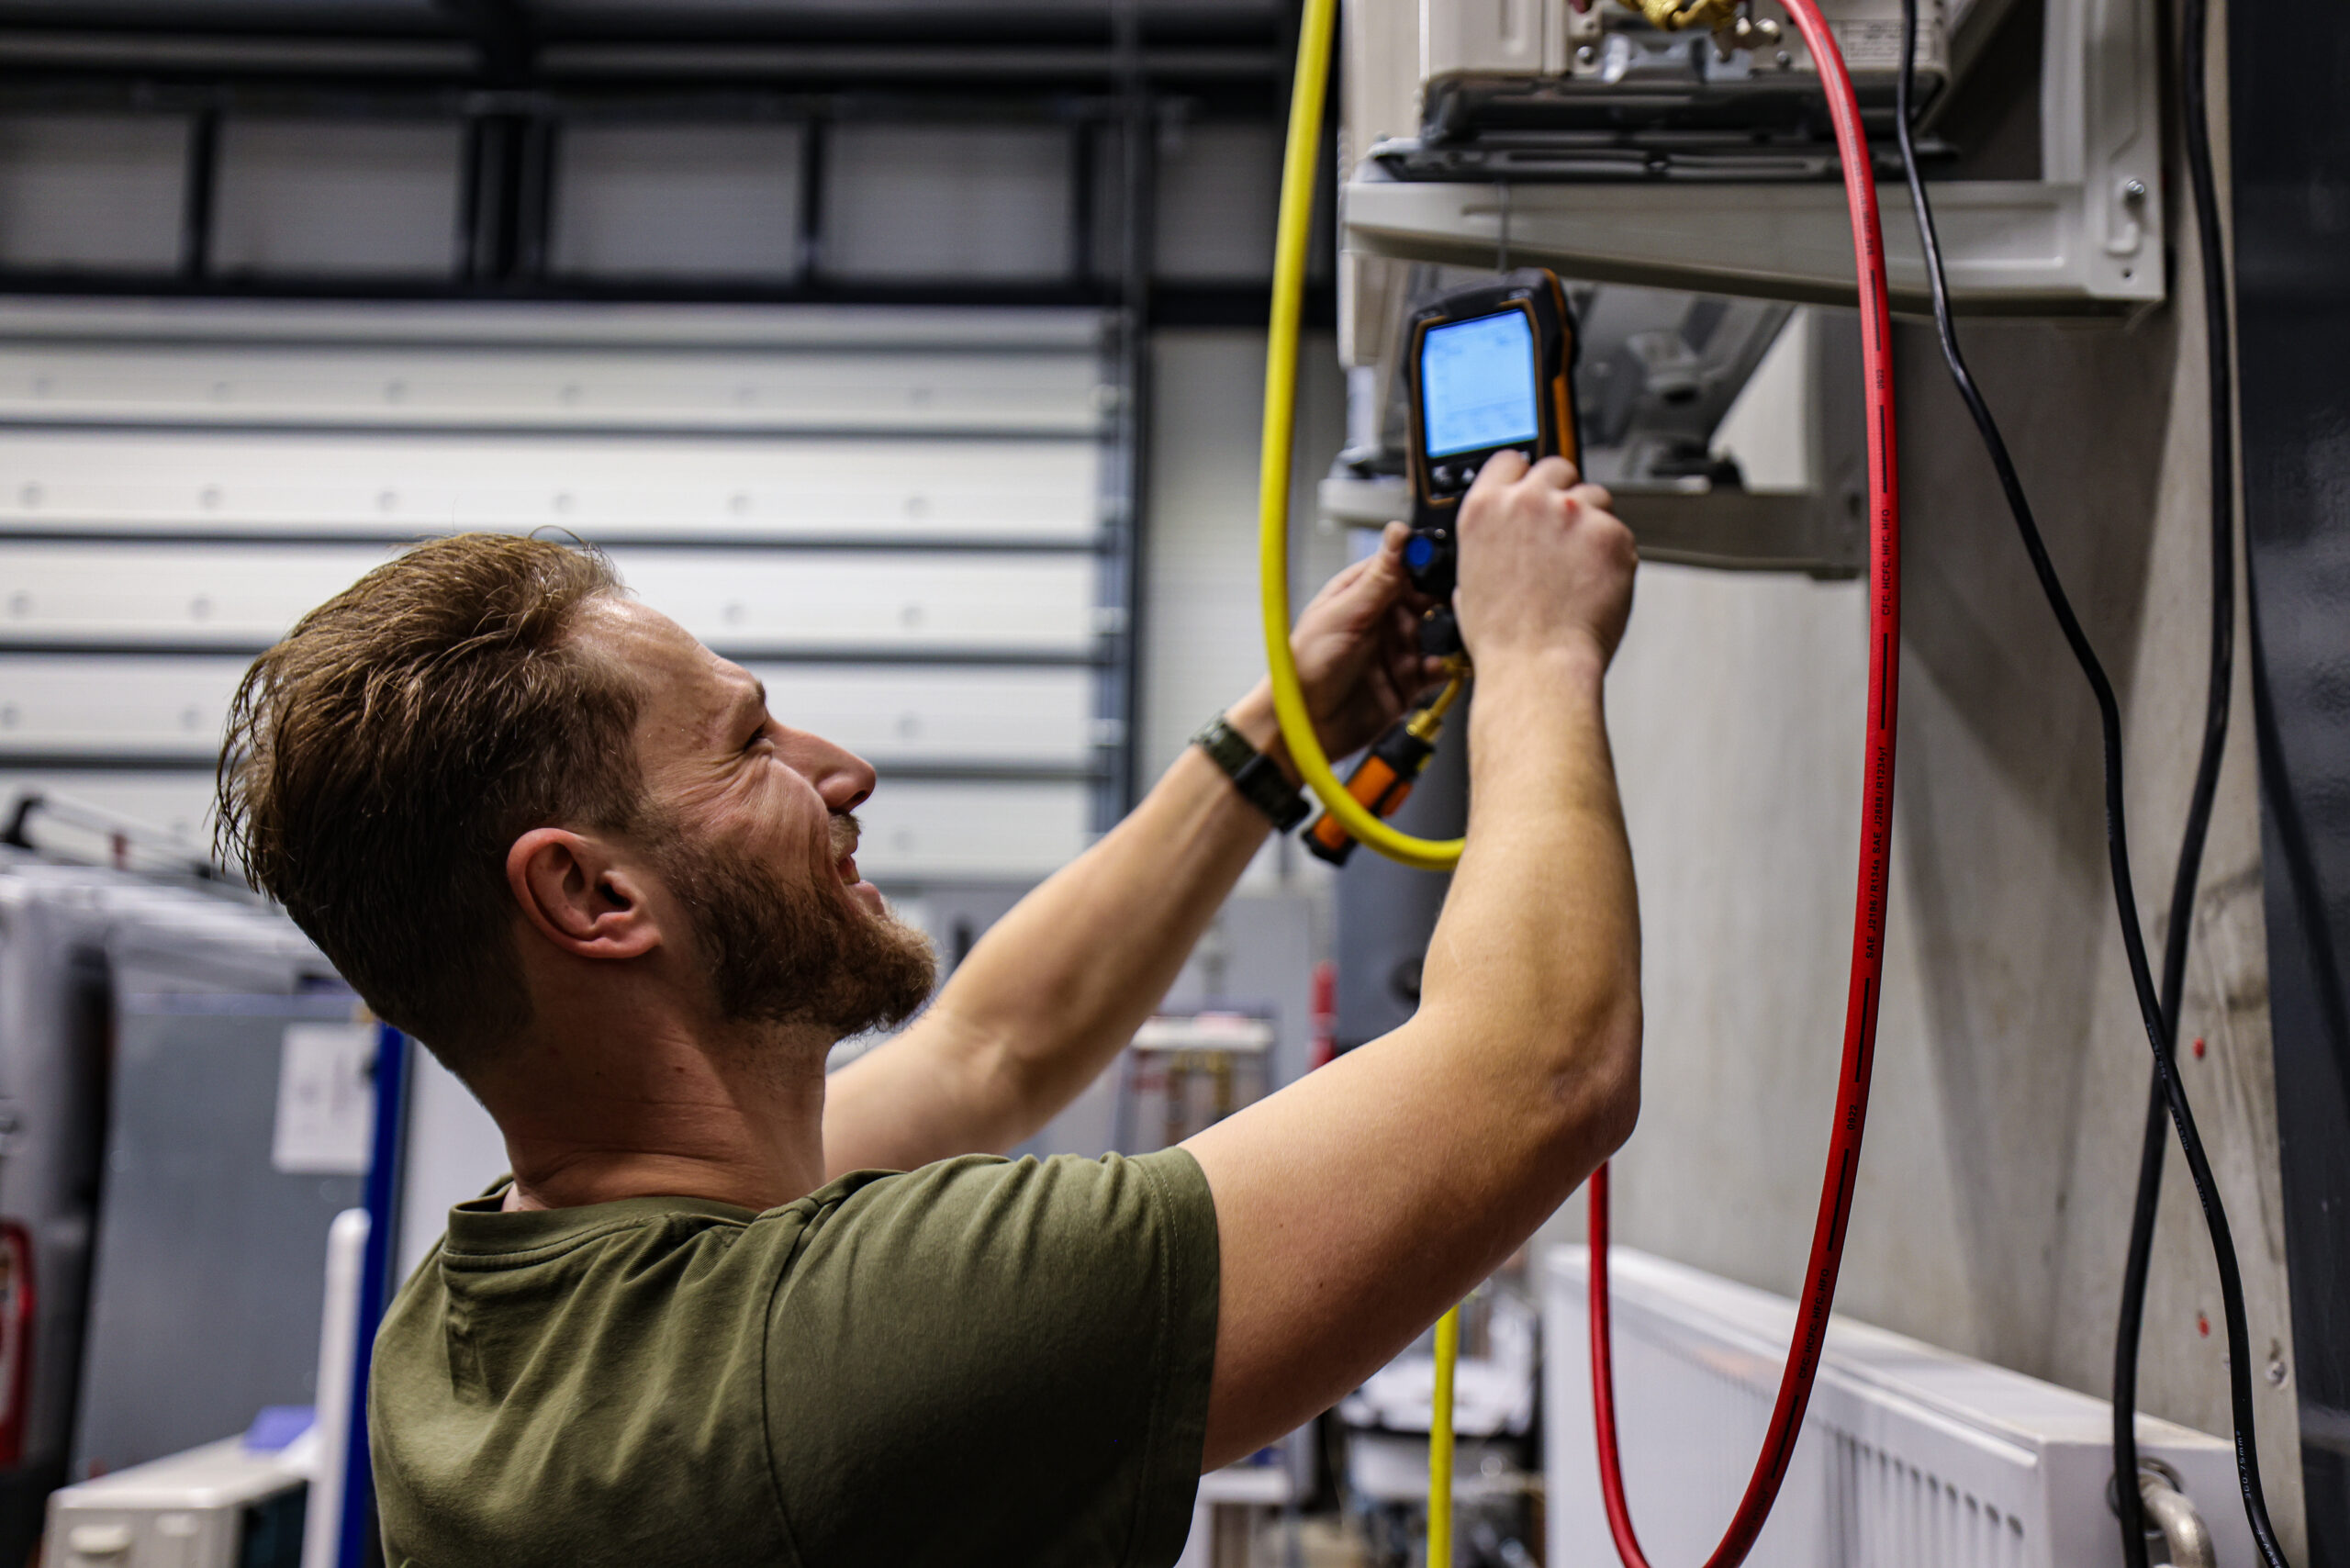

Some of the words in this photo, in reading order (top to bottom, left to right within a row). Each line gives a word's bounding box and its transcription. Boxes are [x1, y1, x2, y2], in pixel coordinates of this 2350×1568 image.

[1881, 509, 1890, 530] HFO
[1882, 558, 1891, 589] HCFC,
[1882, 591, 1892, 616] CFC,
[1865, 936, 1875, 959] SAE
[1873, 832, 1882, 854] SAE
[1818, 1269, 1830, 1292] HFO
